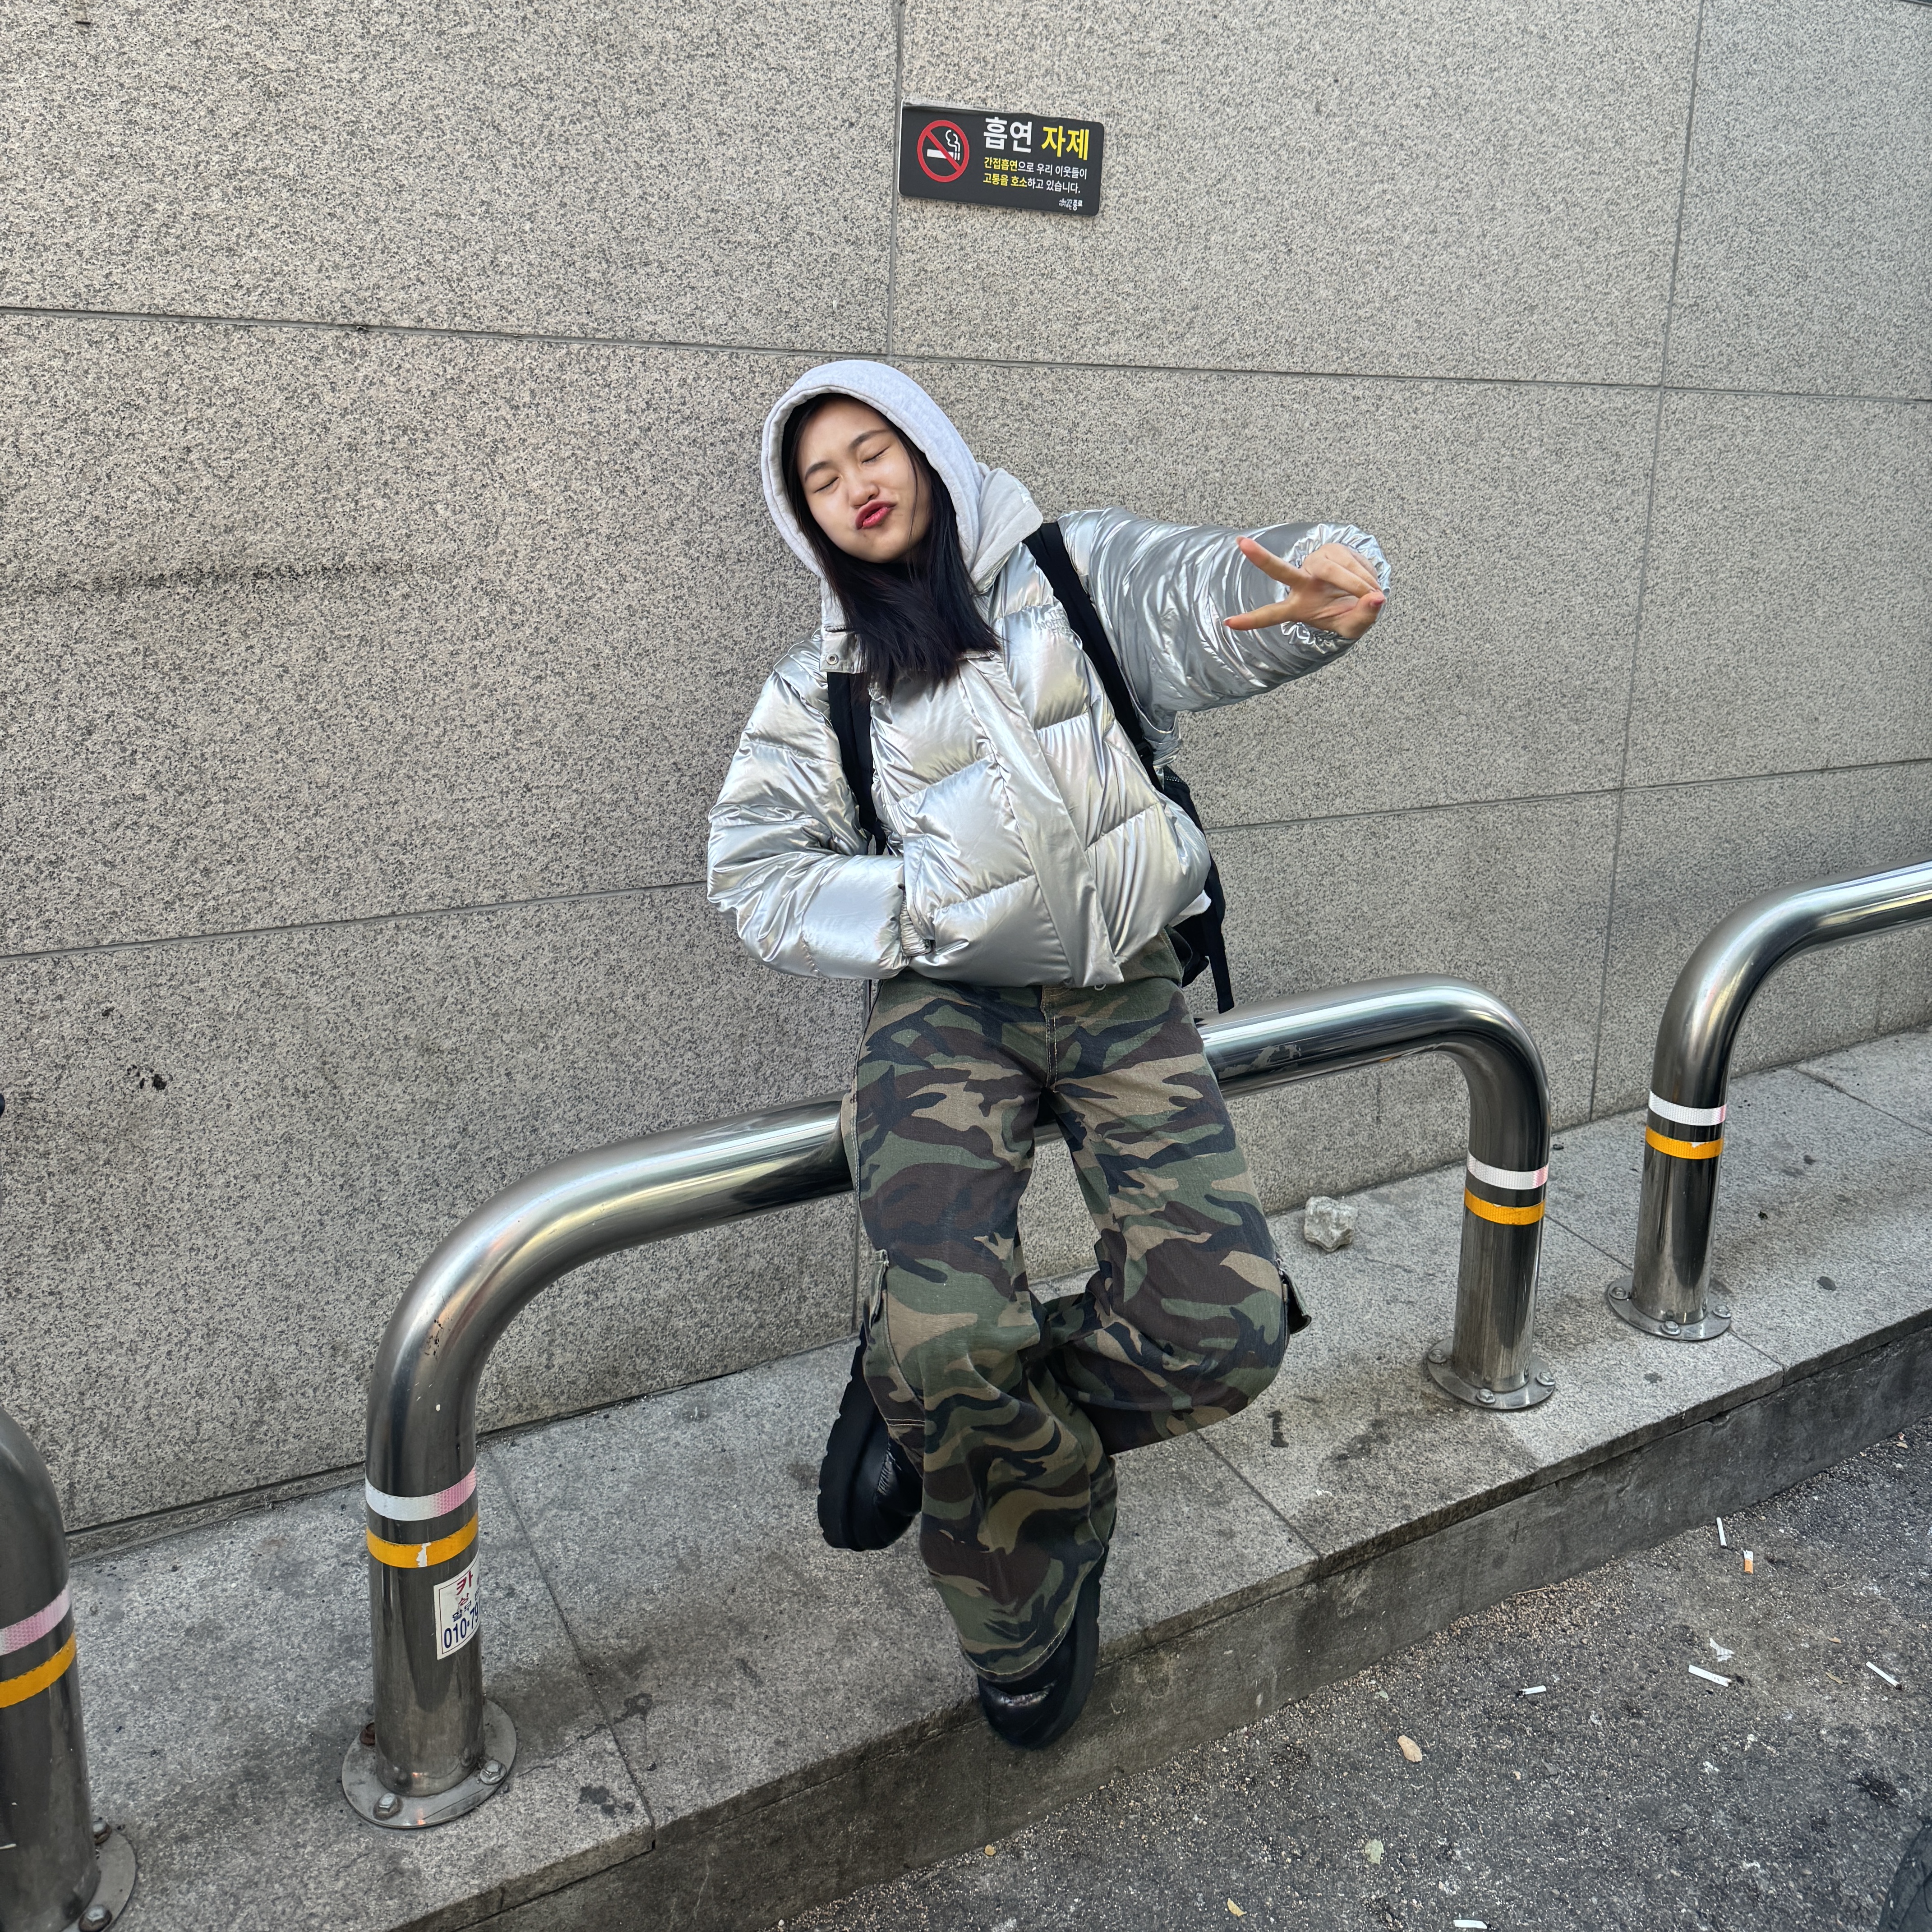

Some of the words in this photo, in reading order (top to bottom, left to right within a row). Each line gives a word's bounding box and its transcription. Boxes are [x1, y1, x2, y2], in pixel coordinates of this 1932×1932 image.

[984, 117, 1032, 153] 흡연
[1042, 126, 1089, 161] 자제
[984, 157, 1034, 172] 간접흡연으로
[1037, 163, 1053, 176] 우리
[1055, 165, 1087, 179] 이웃들이
[983, 173, 1009, 186] 고통을
[1010, 175, 1043, 189] 호소하고
[1046, 180, 1081, 194] 있습니다.
[1073, 199, 1083, 211] 종로
